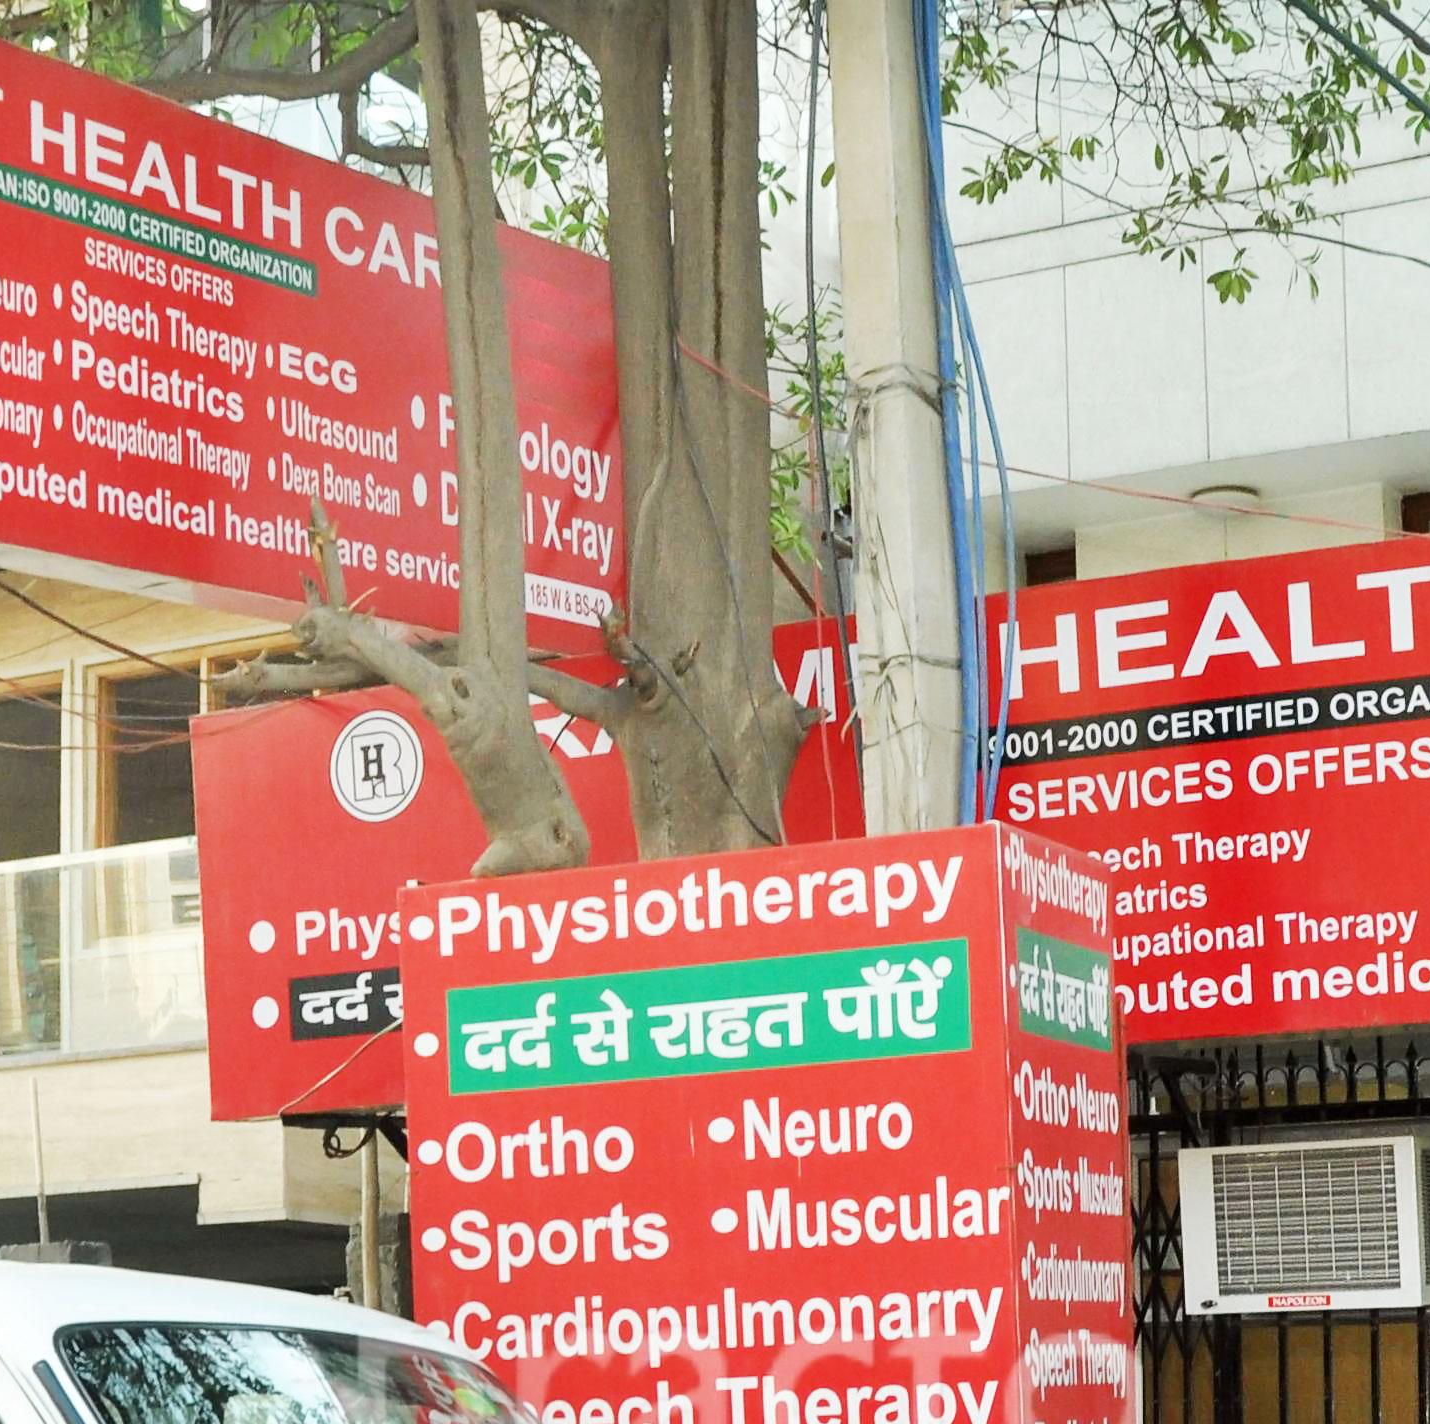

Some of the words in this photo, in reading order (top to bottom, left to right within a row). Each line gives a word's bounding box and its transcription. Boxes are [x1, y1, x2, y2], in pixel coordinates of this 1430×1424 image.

[28, 101, 303, 249] HEALTH
[53, 184, 126, 231] 9001-2000
[129, 210, 206, 260] CERTIFIED
[209, 240, 313, 291] ORGANIZATION
[84, 236, 168, 288] SERVICES
[170, 270, 234, 307] OFFERS
[71, 286, 160, 346] Speech
[166, 308, 258, 379] Therapy
[278, 343, 358, 394] ECG
[71, 341, 245, 423] Pediatrics
[72, 400, 183, 466] Occupational
[186, 428, 251, 492] Therapy
[280, 398, 399, 463] Ultrasound
[97, 476, 216, 537] medical
[224, 505, 311, 557] health
[338, 529, 377, 572] are
[281, 457, 321, 500] Dexa
[323, 464, 362, 508] Bone
[365, 472, 401, 518] Scan
[542, 494, 614, 577] X-ray
[1147, 698, 1319, 745] CERTIFIED
[1007, 758, 1234, 823] SERVICES
[1010, 832, 1108, 937] Physiotherapy
[1173, 825, 1312, 871] Therapy
[437, 854, 964, 964] Physiotherapy
[1275, 907, 1419, 958] Therapy
[298, 971, 374, 1026] दर्द
[1019, 944, 1040, 1016] दर्द
[462, 994, 557, 1074] दर्द
[571, 988, 633, 1068] से
[649, 990, 808, 1060] राहत
[1021, 1060, 1070, 1128] Ortho
[1076, 1072, 1120, 1135] Neuro
[444, 1116, 635, 1184] Ortho
[742, 1095, 913, 1162] Neuro
[1023, 1147, 1073, 1225] Sports
[1079, 1156, 1123, 1217] Muscular
[449, 1202, 671, 1283] Sports
[746, 1177, 1009, 1252] Muscular
[1027, 1240, 1126, 1319] Cardiopulmonarry
[1272, 1296, 1327, 1307] NAPOLEON
[453, 1286, 1004, 1367] Cardiopulmonarry
[1030, 1327, 1078, 1402] Speech
[1078, 1328, 1127, 1399] Therapy
